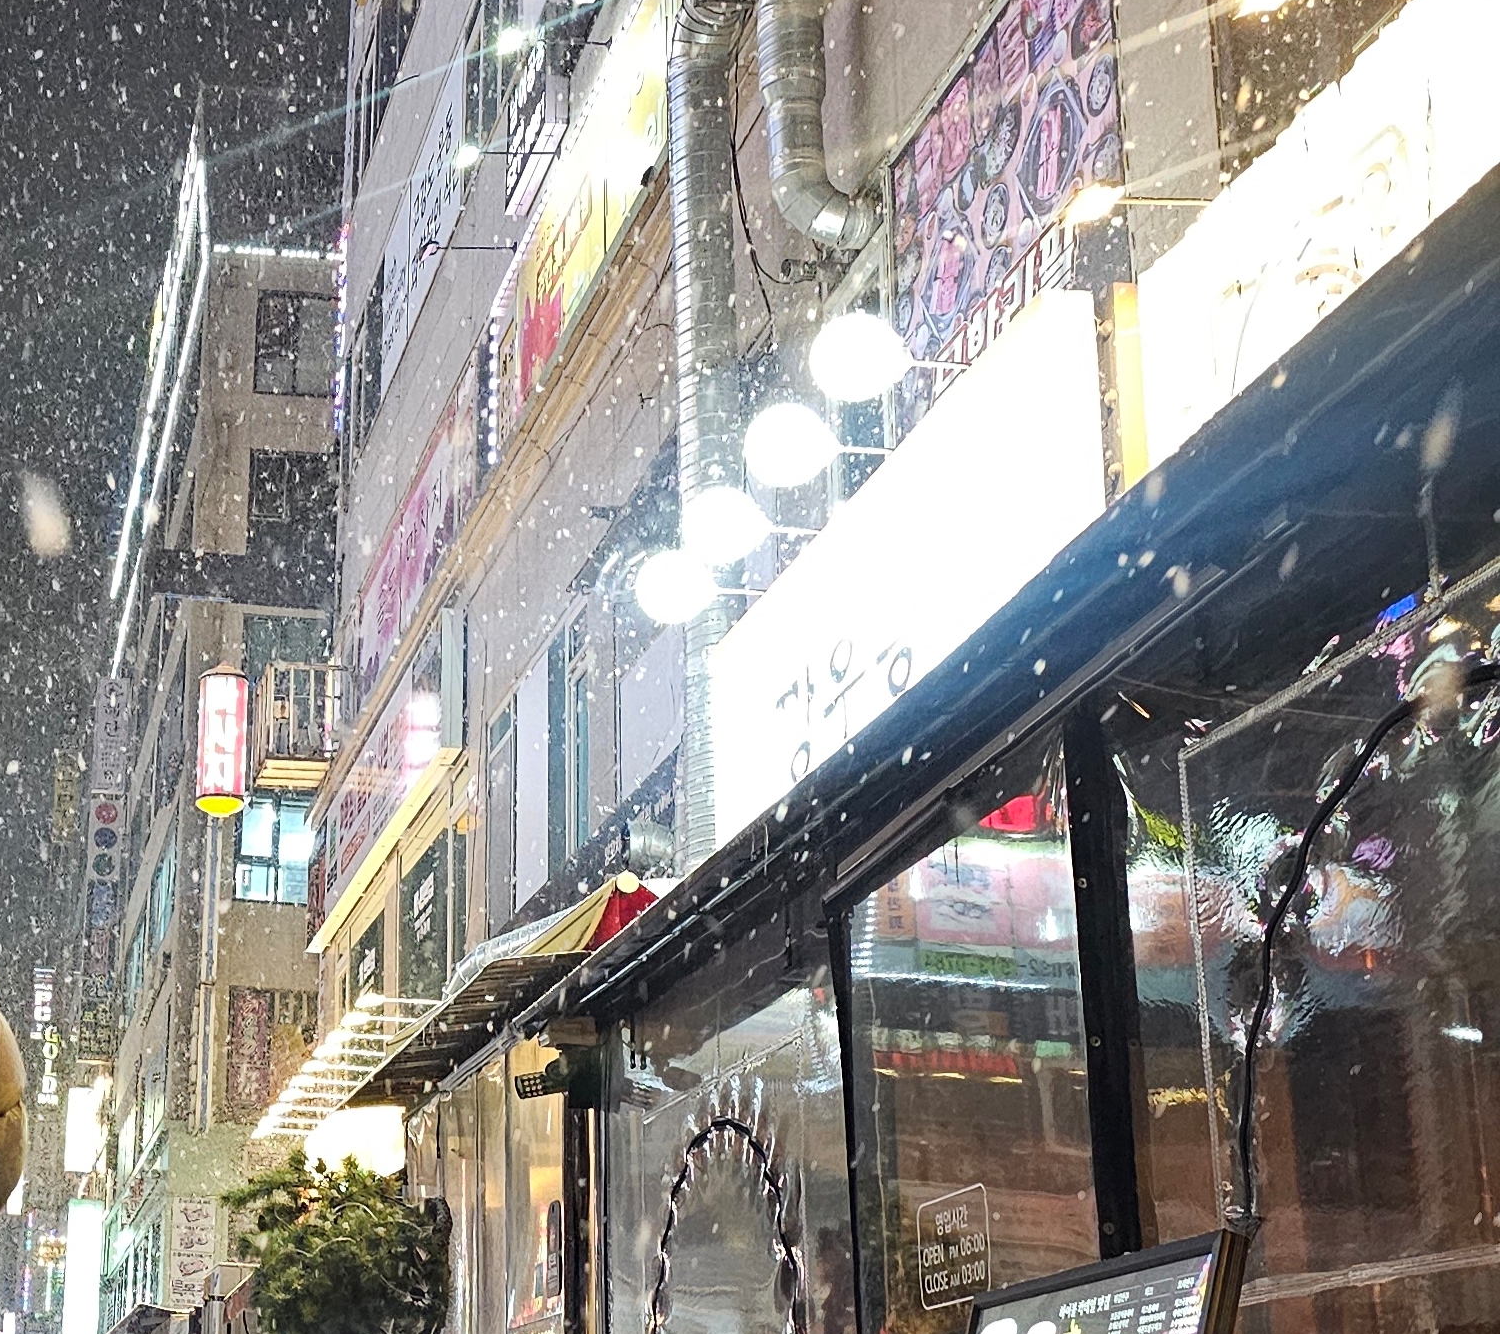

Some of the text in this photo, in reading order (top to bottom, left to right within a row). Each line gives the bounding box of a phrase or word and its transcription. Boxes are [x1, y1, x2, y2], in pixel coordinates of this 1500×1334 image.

[922, 1244, 946, 1269] OPEN
[959, 1232, 987, 1257] 06:00
[924, 1271, 950, 1295] CLOSE
[960, 1265, 986, 1287] 03:00
